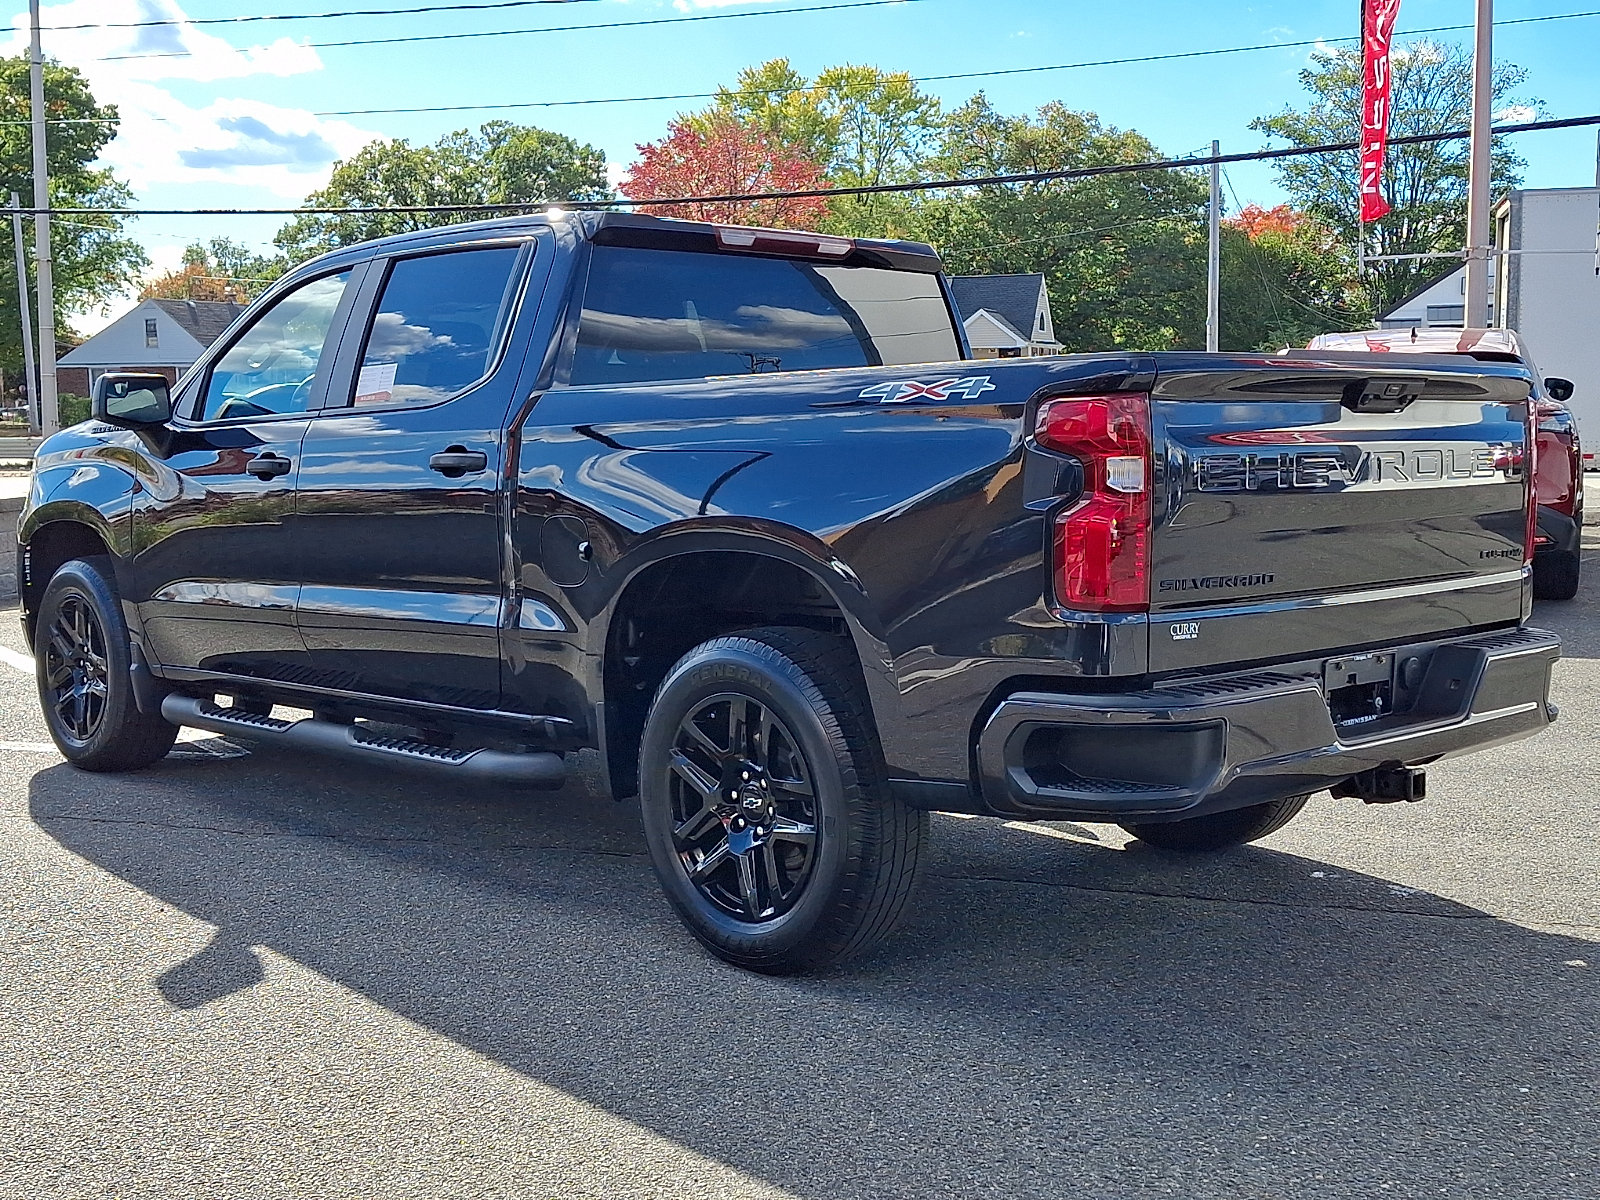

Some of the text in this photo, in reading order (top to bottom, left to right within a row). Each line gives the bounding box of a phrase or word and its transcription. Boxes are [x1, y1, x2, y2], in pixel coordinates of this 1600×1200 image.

[858, 375, 997, 403] 4X4
[1197, 442, 1520, 492] CHEVROLET
[1159, 572, 1275, 592] SILVERADO
[1170, 622, 1200, 636] CURRY
[691, 662, 772, 696] GENERAL
